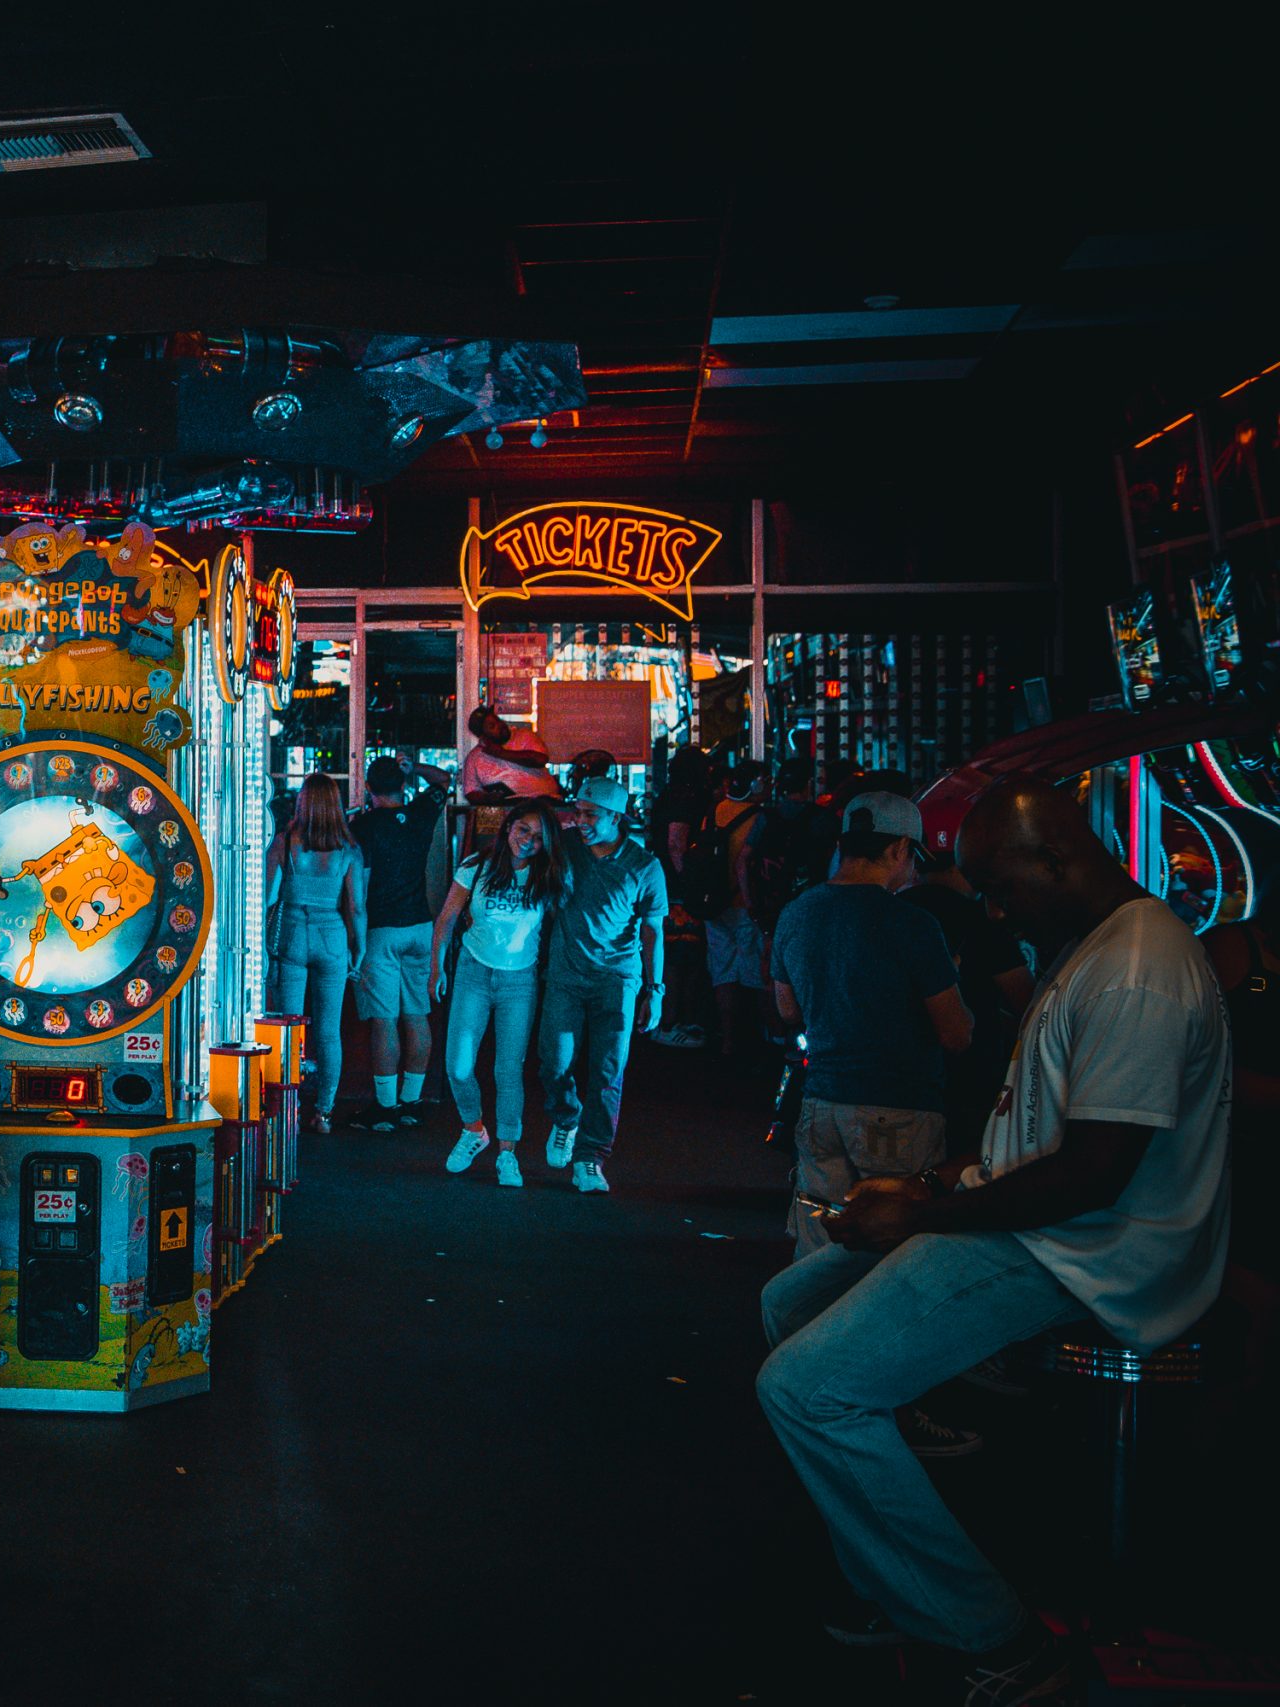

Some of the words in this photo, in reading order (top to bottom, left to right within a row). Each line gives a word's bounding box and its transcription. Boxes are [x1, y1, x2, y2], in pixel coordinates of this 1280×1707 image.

[495, 514, 697, 590] TICKETS
[486, 899, 518, 914] Day
[49, 1012, 65, 1026] 50
[126, 1035, 161, 1052] 25¢
[67, 1078, 85, 1101] 0
[37, 1193, 74, 1210] 25¢
[161, 1239, 185, 1250] TICKETS
